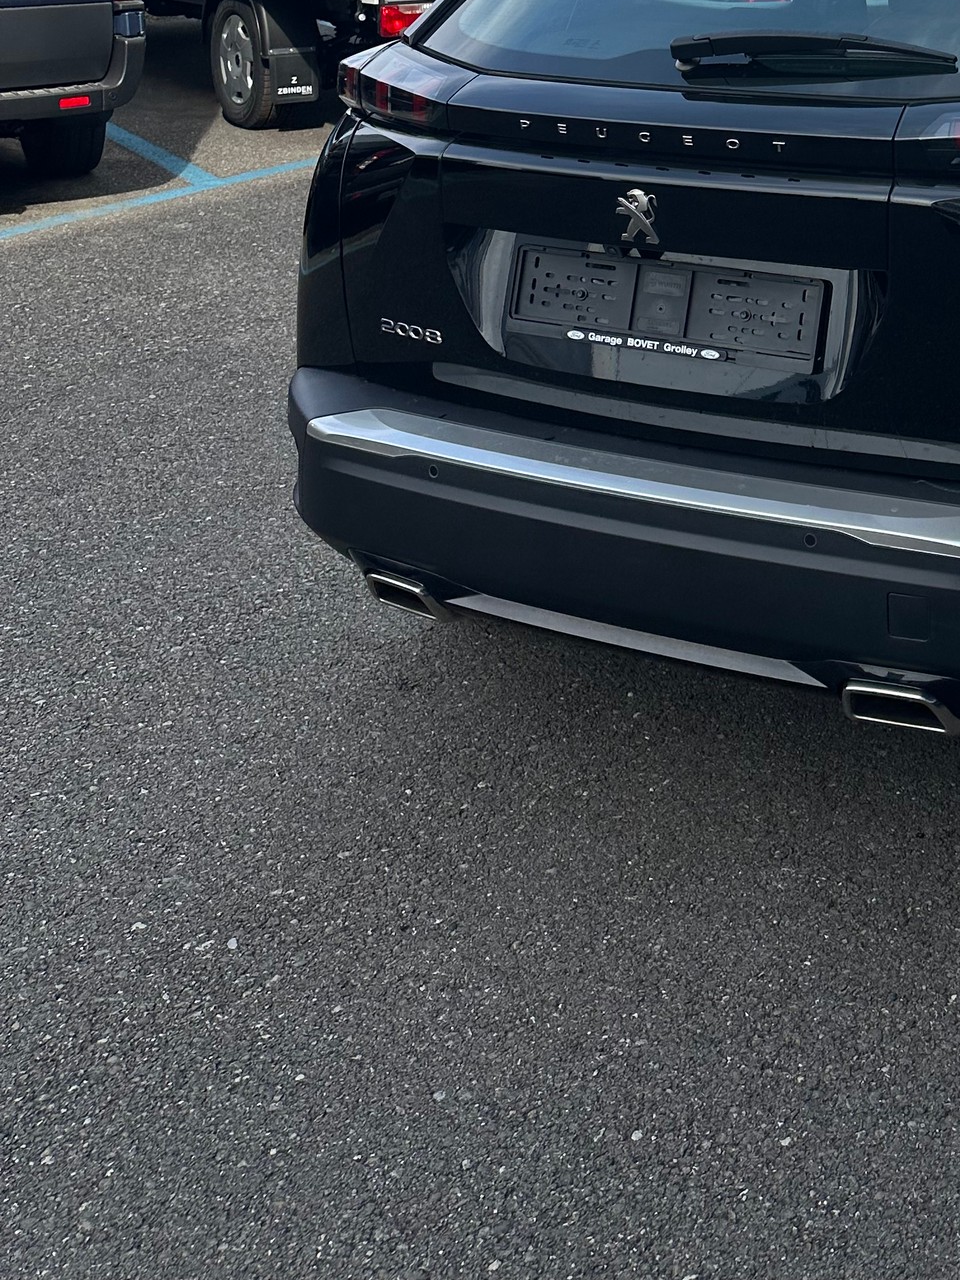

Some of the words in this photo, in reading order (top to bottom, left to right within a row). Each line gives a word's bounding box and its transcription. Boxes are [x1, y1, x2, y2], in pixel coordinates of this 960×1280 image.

[277, 85, 313, 95] ZBINDEN
[291, 76, 298, 84] Z
[519, 119, 786, 153] PEUGEOT
[380, 317, 443, 345] 2008
[588, 332, 623, 346] Garage
[627, 337, 660, 350] BOVET
[663, 342, 698, 357] Grolley
